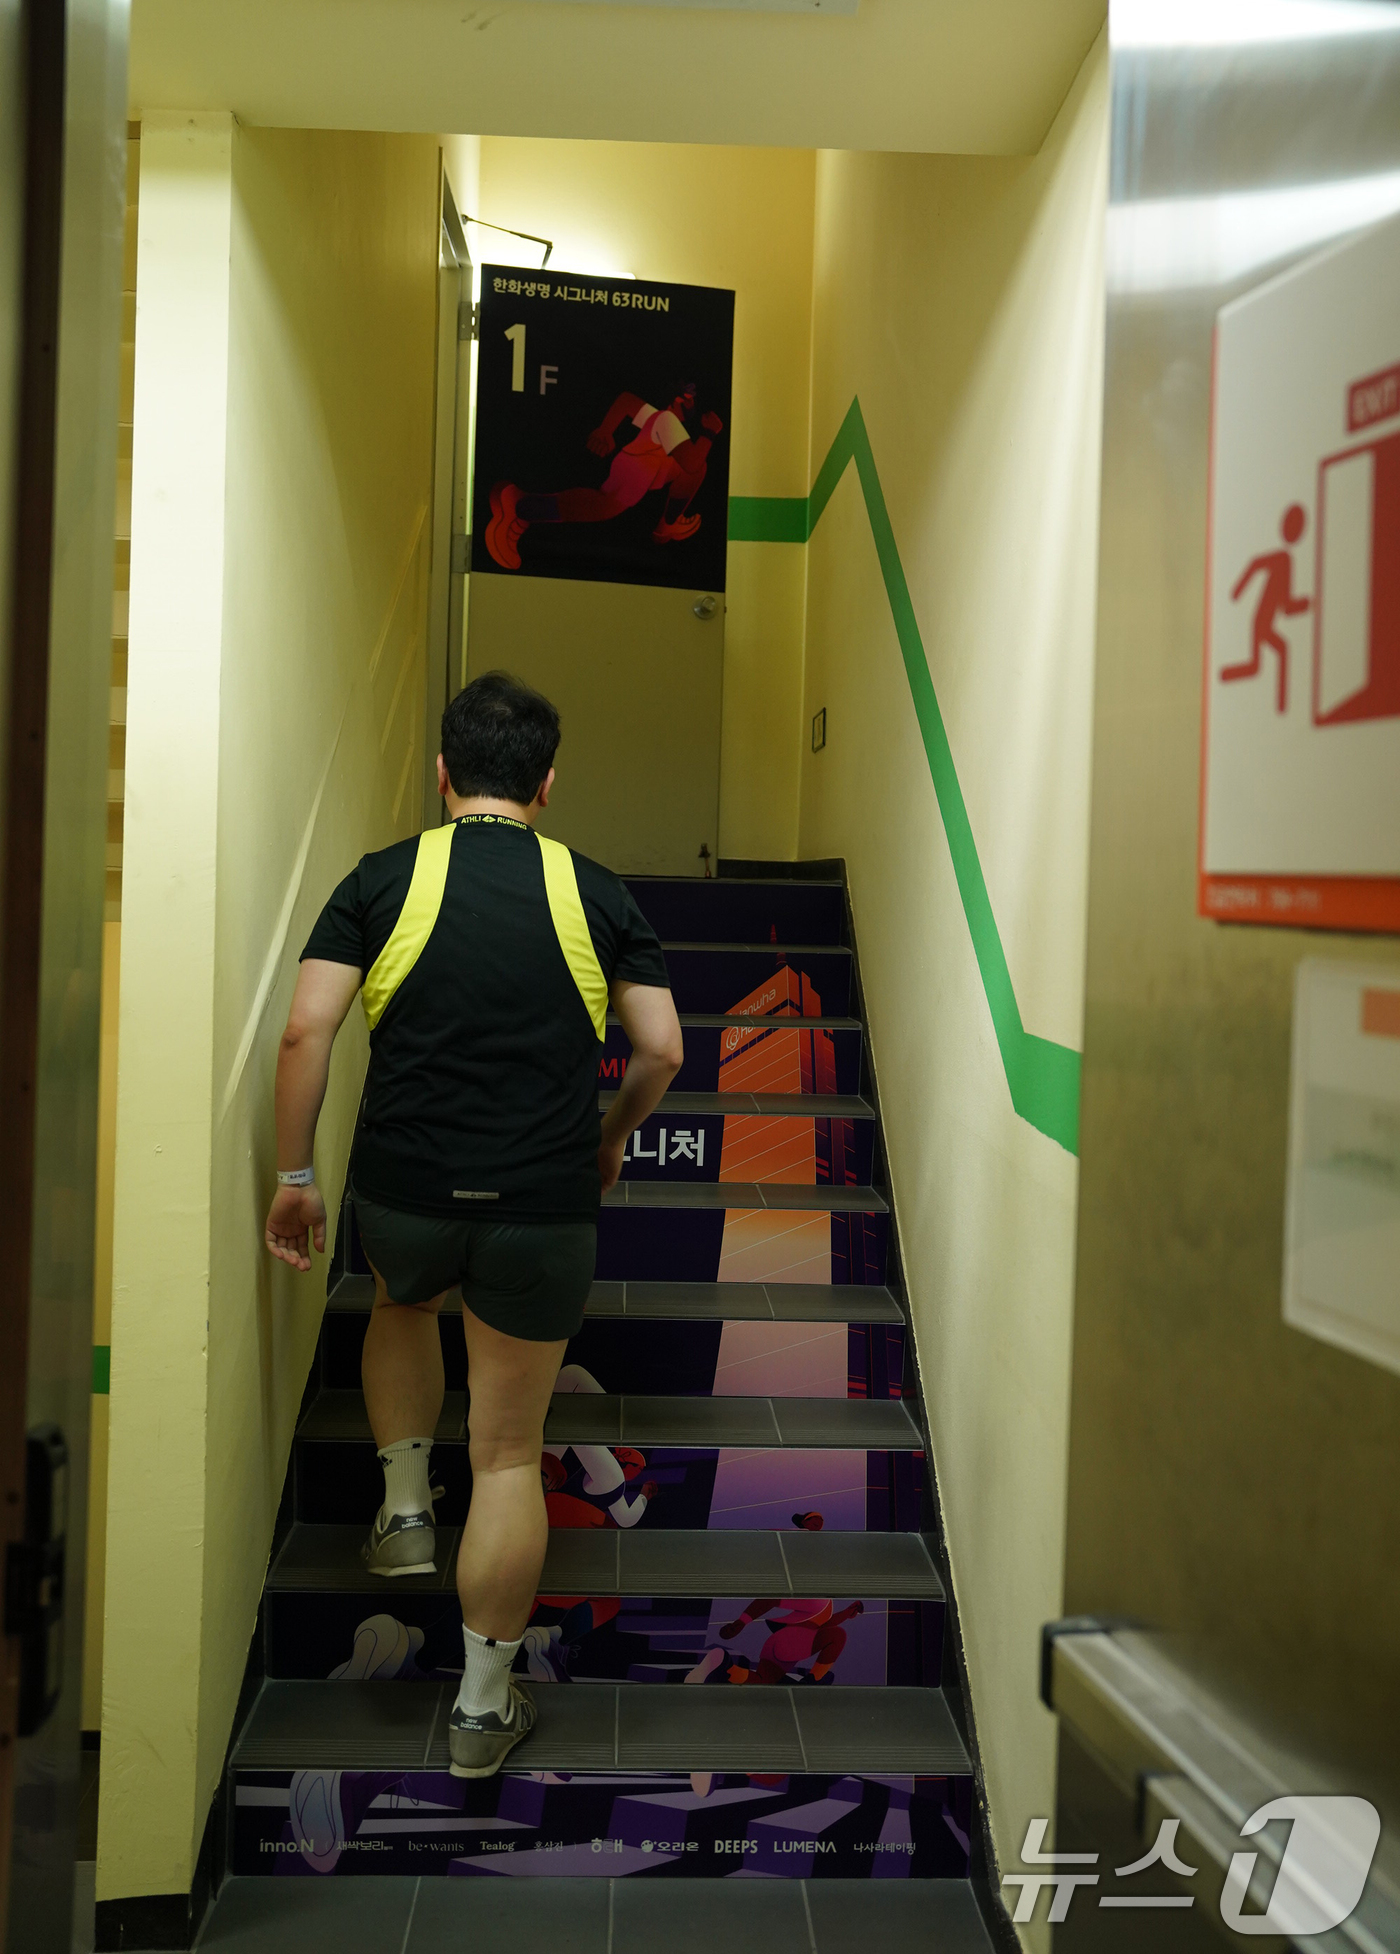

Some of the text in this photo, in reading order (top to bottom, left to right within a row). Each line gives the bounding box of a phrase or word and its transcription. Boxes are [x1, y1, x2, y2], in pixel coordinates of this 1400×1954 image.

[493, 277, 670, 312] 한화생명 시그니처 63RUN
[503, 323, 559, 395] 1 F
[461, 815, 527, 830] ATHLI RUNNING
[622, 1127, 706, 1167] 니처
[401, 1521, 424, 1529] balance
[460, 1722, 483, 1730] balance
[479, 1841, 515, 1852] Tealog
[657, 1841, 699, 1852] 오리온
[714, 1839, 758, 1854] DEEPS
